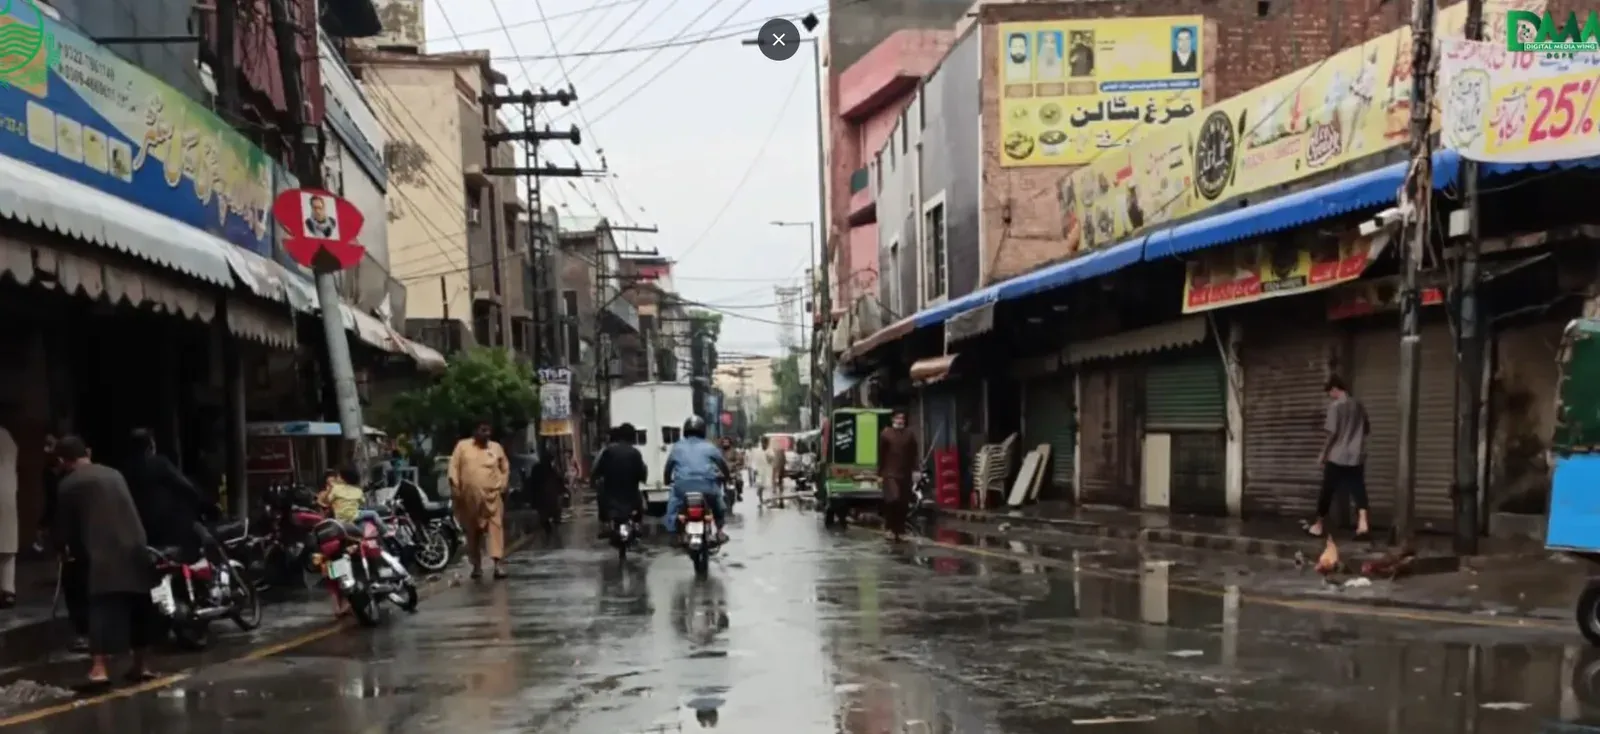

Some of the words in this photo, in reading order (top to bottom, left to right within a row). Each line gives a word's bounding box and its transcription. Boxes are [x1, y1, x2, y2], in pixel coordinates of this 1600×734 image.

[1070, 101, 1140, 128] سالن
[1144, 97, 1195, 125] مرغ
[1528, 76, 1600, 142] 25%
